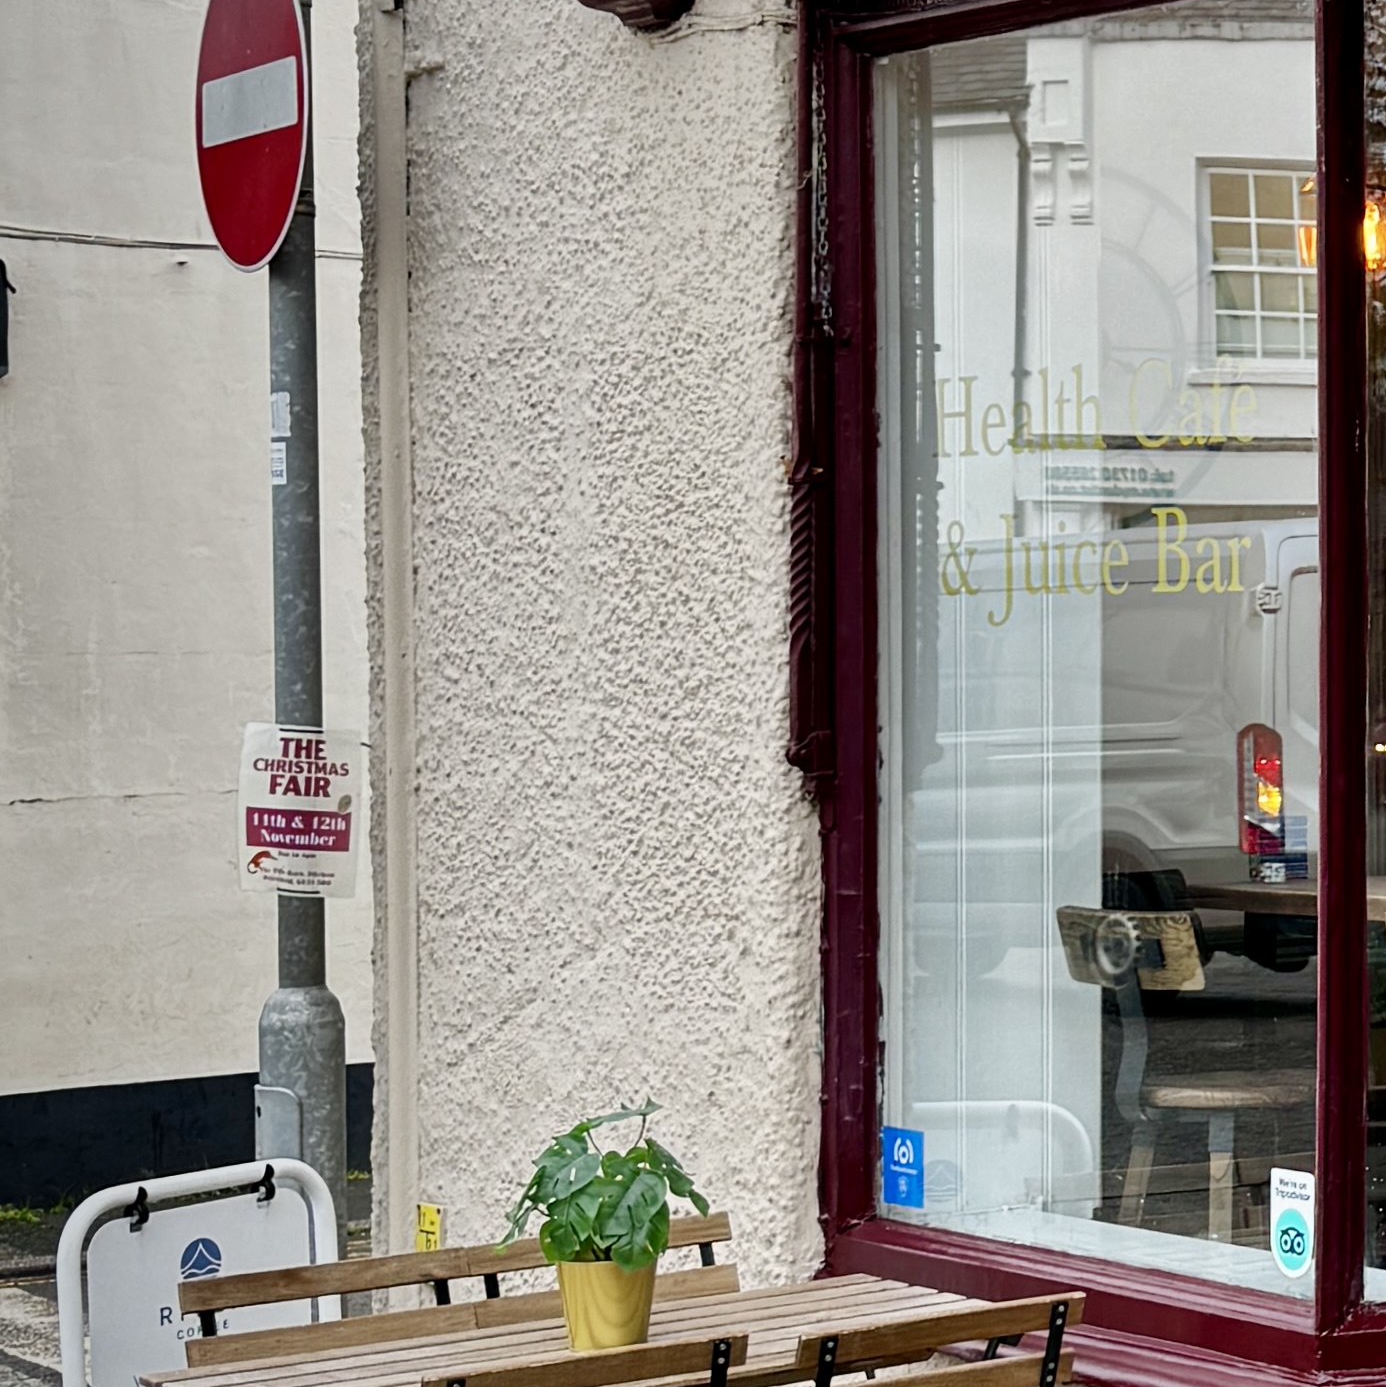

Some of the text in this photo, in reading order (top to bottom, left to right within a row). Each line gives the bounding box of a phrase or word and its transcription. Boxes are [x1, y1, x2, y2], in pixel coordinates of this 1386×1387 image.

[933, 363, 1107, 458] Health
[940, 506, 1251, 627] & Juice Bar
[279, 737, 327, 761] THE
[253, 757, 350, 777] CHRISTMAS
[268, 774, 331, 798] FAIR
[252, 812, 347, 831] 11th & 12th
[260, 828, 337, 847] November
